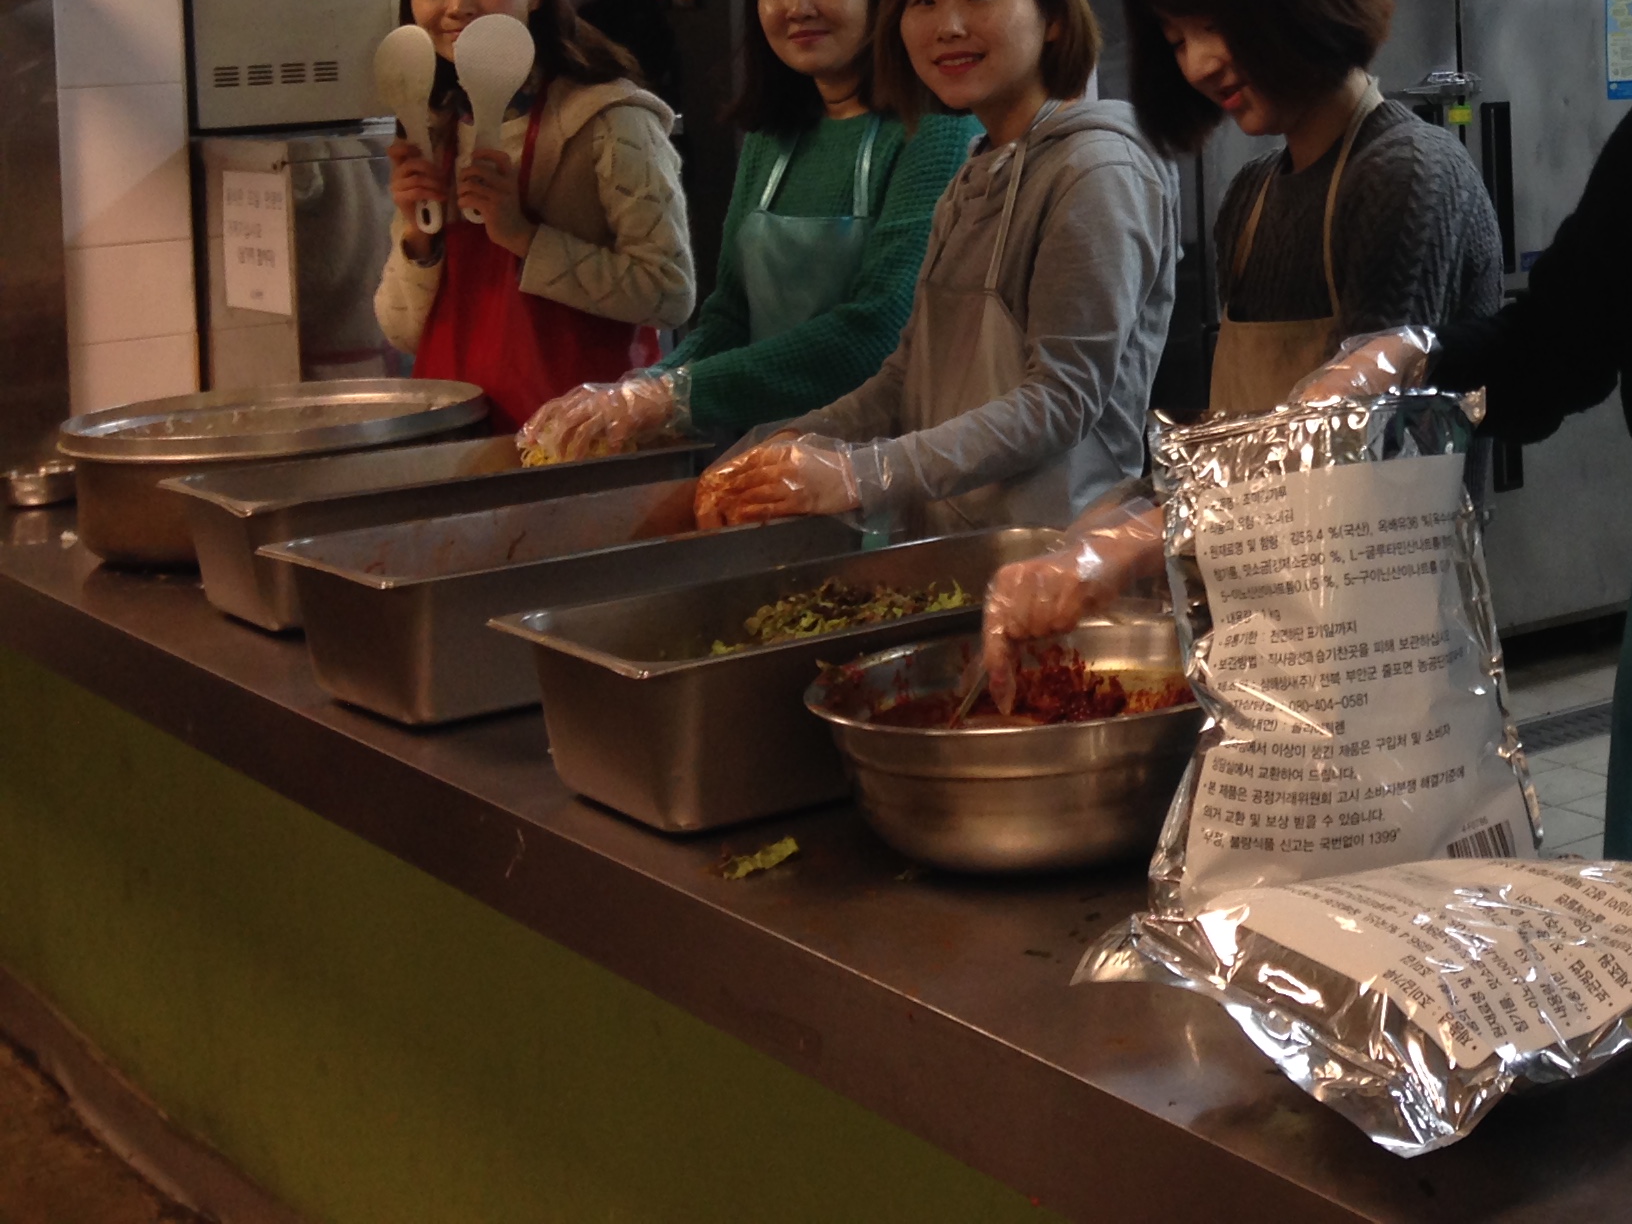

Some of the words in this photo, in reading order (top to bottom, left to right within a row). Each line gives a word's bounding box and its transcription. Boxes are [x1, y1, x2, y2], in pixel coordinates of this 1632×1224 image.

[1316, 642, 1369, 664] 습기찬곳을
[1373, 638, 1395, 654] 피해
[1319, 671, 1341, 688] 전북
[1346, 665, 1377, 683] 부안군
[1271, 742, 1305, 759] 이상이
[1338, 739, 1371, 758] 제품은
[1375, 733, 1407, 752] 구입처
[1410, 731, 1421, 747] 및
[1425, 723, 1451, 743] 소비자
[1258, 765, 1304, 782] 교환하여
[1218, 783, 1248, 802] 제품은
[1252, 787, 1332, 806] 공정거래위원회
[1336, 787, 1361, 803] 고시
[1225, 810, 1246, 827] 교환
[1249, 812, 1261, 828] 및
[1265, 814, 1290, 830] 보상
[1322, 814, 1334, 828] 수
[1338, 807, 1386, 827] 있습니다.
[1230, 835, 1275, 852] 불량식품
[1280, 836, 1315, 853] 신고는
[1319, 832, 1365, 852] 국번없이
[1582, 884, 1607, 901] 생긴
[1400, 954, 1435, 977] 조미김
[1598, 952, 1631, 988] 제조원
[1382, 969, 1435, 1009] 조미김가루
[1568, 959, 1611, 1003] 보관방법
[1470, 991, 1507, 1038] 원재료명
